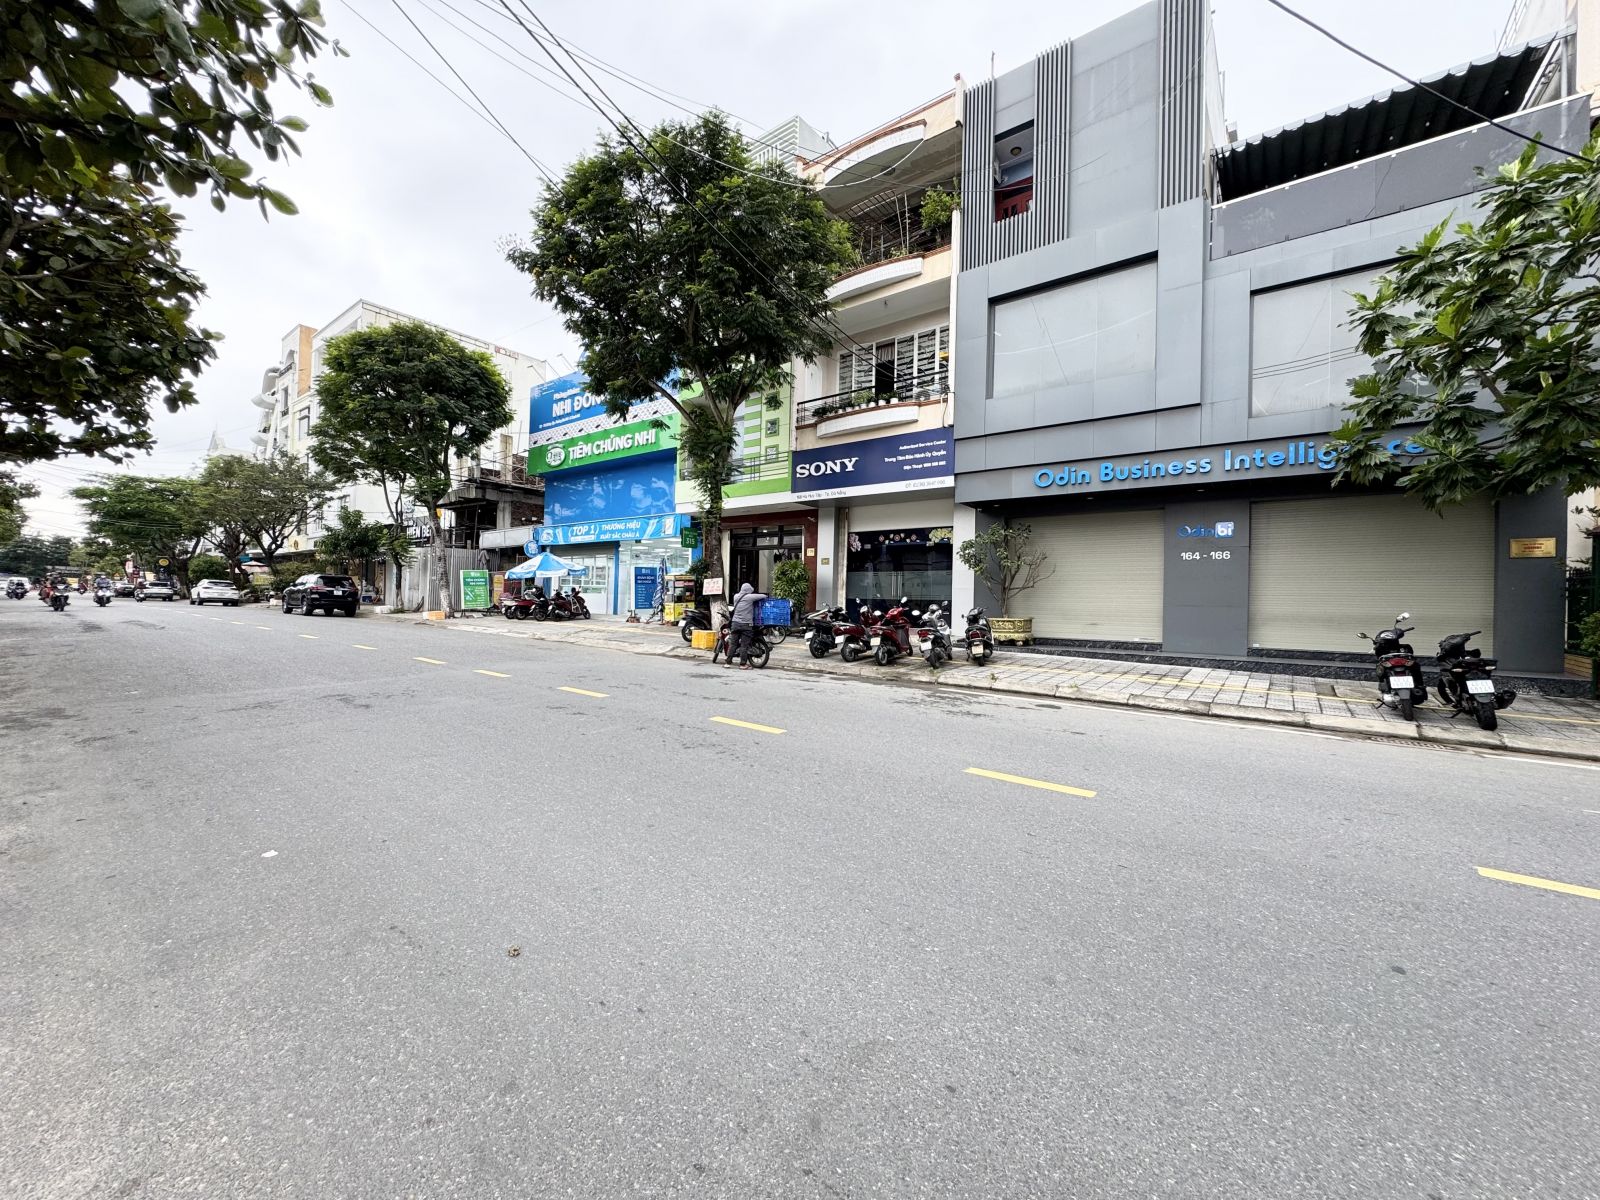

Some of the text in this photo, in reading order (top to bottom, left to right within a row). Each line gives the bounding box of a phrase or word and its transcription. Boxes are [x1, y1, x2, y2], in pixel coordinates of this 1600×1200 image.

[552, 398, 571, 417] NHI
[568, 441, 592, 460] TIÊM
[634, 429, 656, 447] NHI
[796, 457, 859, 478] SONY
[1033, 466, 1091, 489] Odin
[1100, 455, 1212, 483] Business
[573, 524, 595, 536] TOP 1
[1180, 551, 1200, 560] 164
[1209, 551, 1231, 560] 166
